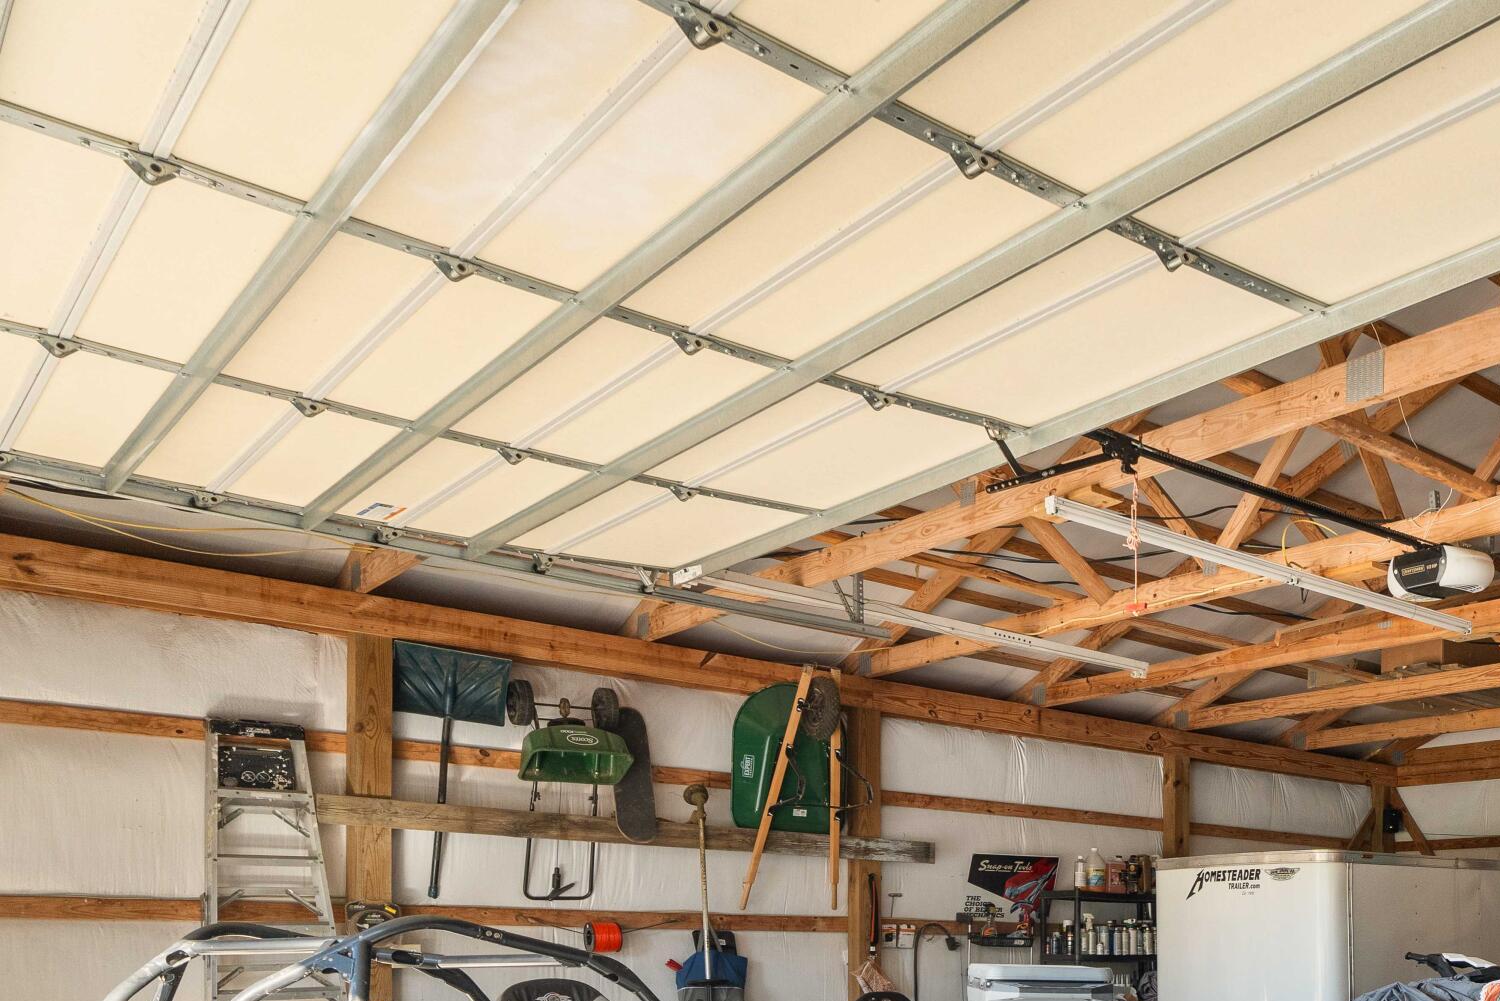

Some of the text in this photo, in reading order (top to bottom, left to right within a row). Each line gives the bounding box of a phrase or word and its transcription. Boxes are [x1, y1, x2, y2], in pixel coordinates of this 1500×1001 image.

[978, 860, 1033, 872] Snap-on Tools
[1186, 869, 1261, 900] HOMESTEADER
